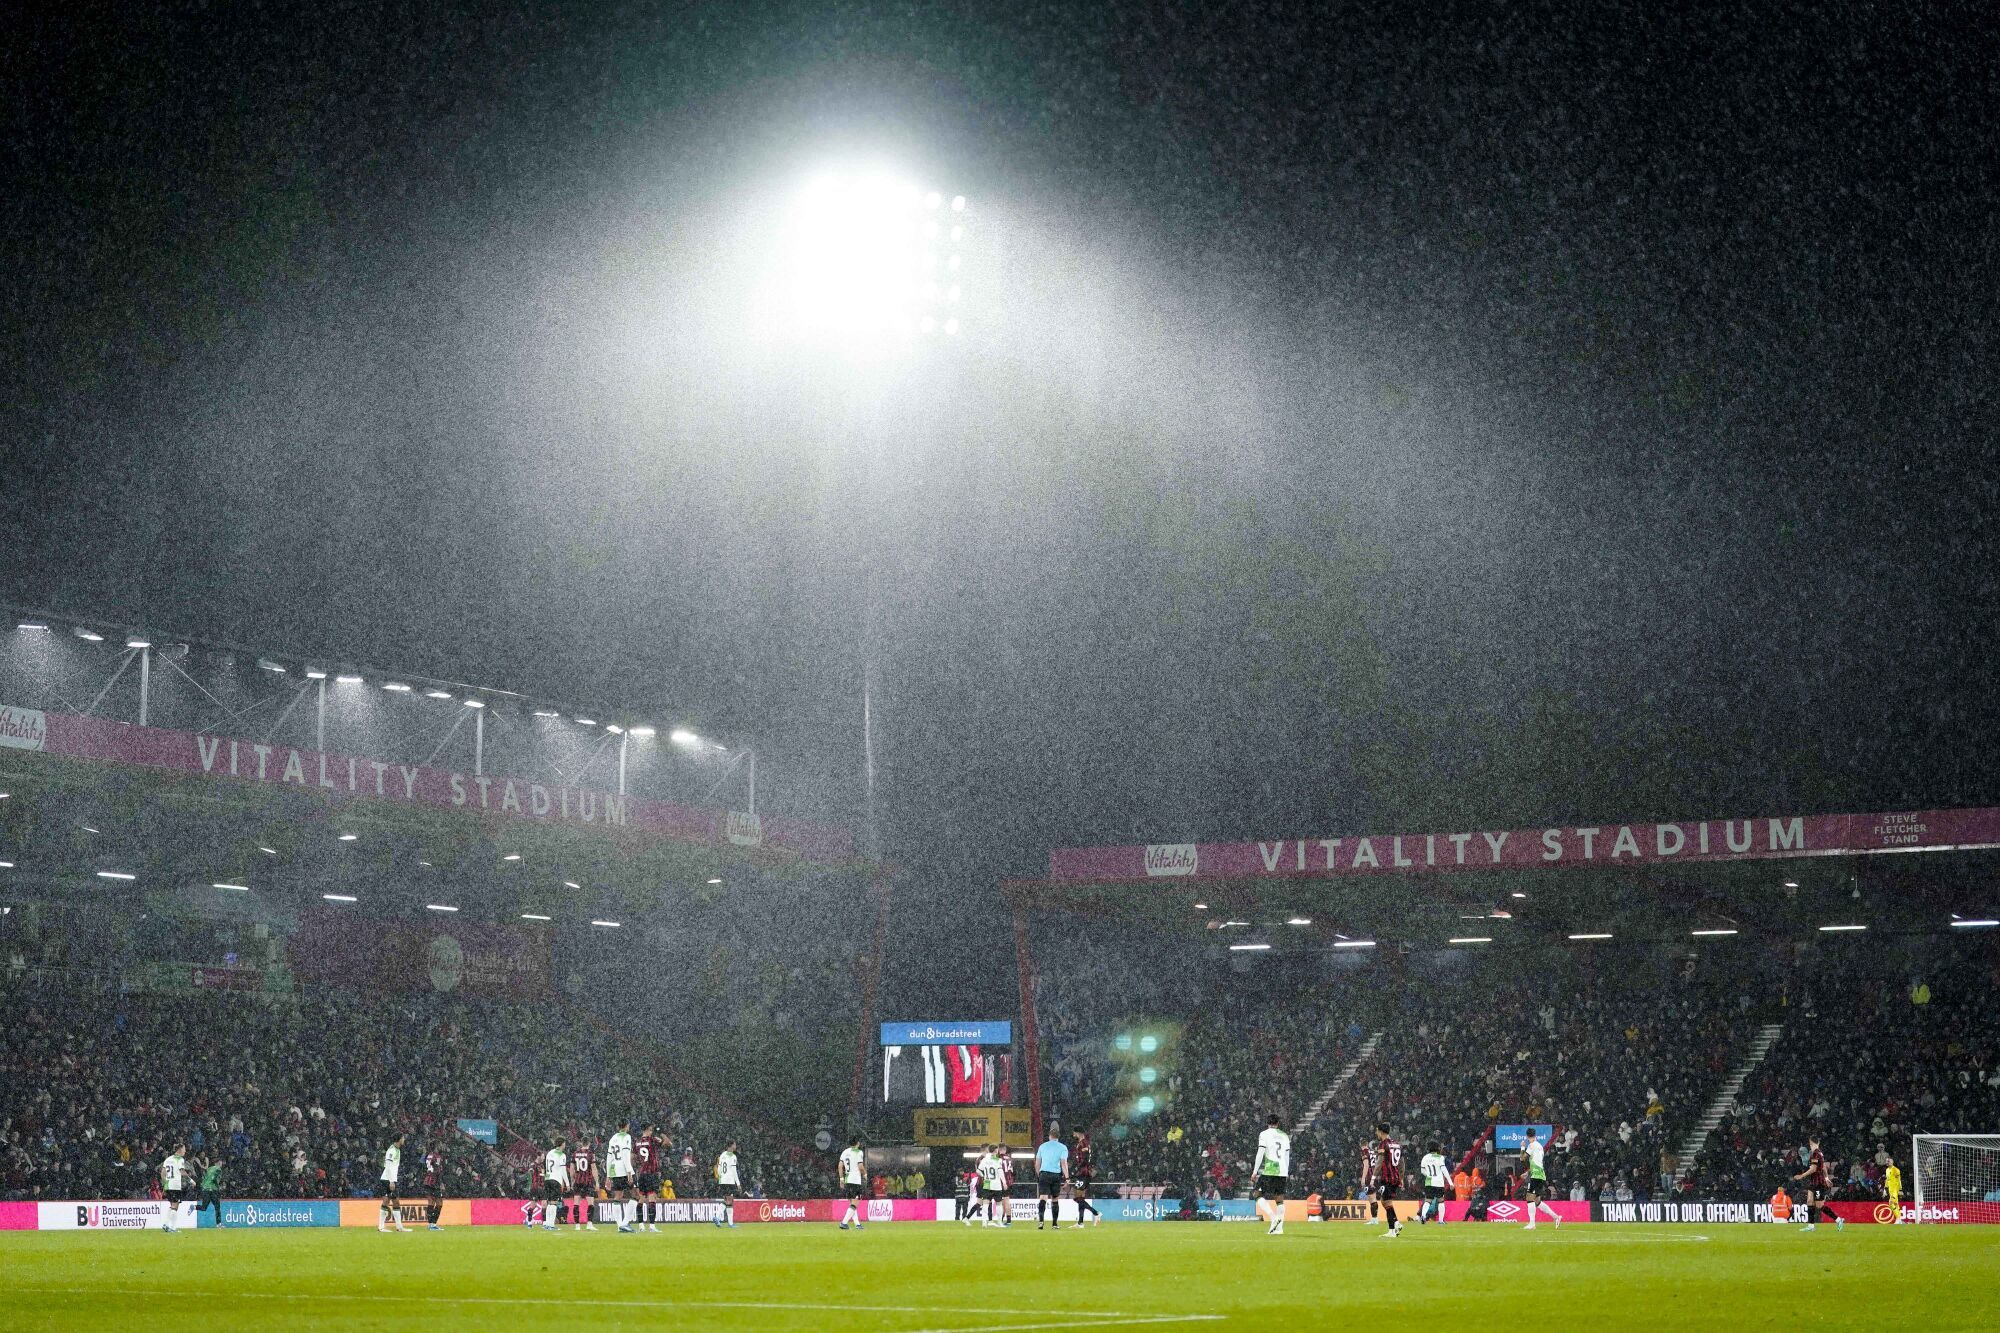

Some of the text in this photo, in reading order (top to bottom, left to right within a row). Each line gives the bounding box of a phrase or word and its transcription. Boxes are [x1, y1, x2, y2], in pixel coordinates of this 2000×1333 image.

[197, 734, 625, 825] VITALITY STADIUM
[1884, 814, 1917, 824] STEVE
[1874, 824, 1927, 834] FLETCHER
[1258, 817, 1804, 871] VITALITY STADIUM
[1883, 834, 1919, 844] STAND
[1147, 847, 1195, 875] Vitality
[640, 1147, 649, 1161] 9
[1391, 1148, 1401, 1167] 19
[575, 1157, 588, 1172] 10
[1427, 1164, 1437, 1177] 11
[166, 1165, 174, 1179] 21
[984, 1166, 996, 1180] 19
[1075, 1180, 1084, 1188] 29
[1815, 1190, 1820, 1198] 3
[102, 1206, 160, 1215] Bournemouth
[664, 1203, 691, 1221] OFFICIAL
[772, 1205, 806, 1220] dafabet
[1601, 1203, 1637, 1222] THANK
[1639, 1203, 1661, 1222] YOU
[1664, 1203, 1678, 1222] TO
[1681, 1203, 1704, 1222] OUR
[1706, 1203, 1751, 1223] OFFICIAL
[102, 1217, 147, 1228] University
